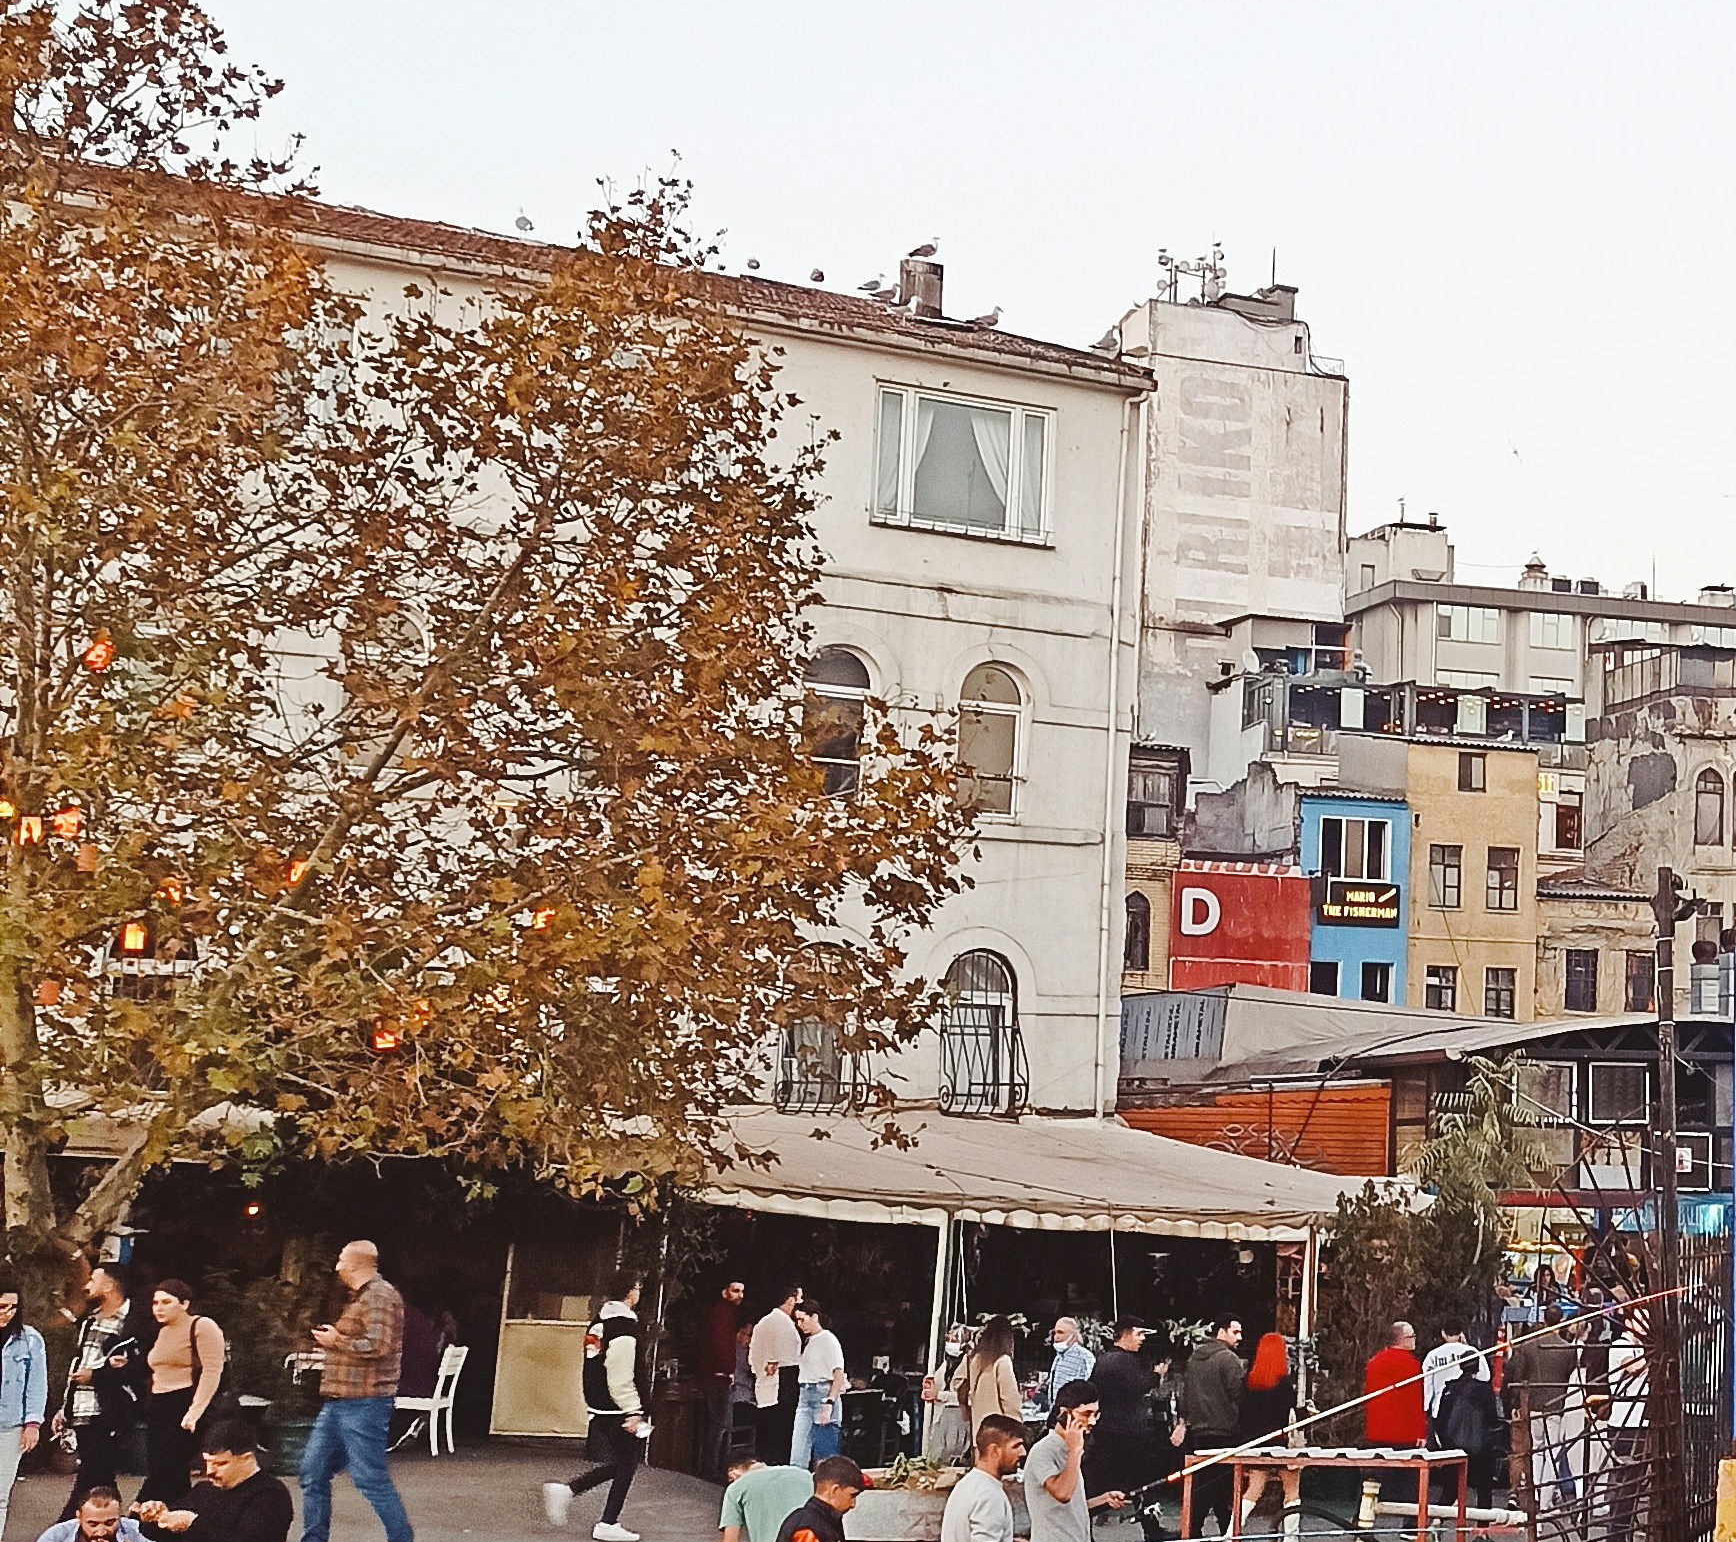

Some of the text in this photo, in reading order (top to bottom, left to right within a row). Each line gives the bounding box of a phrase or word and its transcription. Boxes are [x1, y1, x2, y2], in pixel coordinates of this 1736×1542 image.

[1346, 891, 1376, 903] MARIO
[1181, 887, 1221, 936] D
[1322, 904, 1398, 919] THE FISHERMAN
